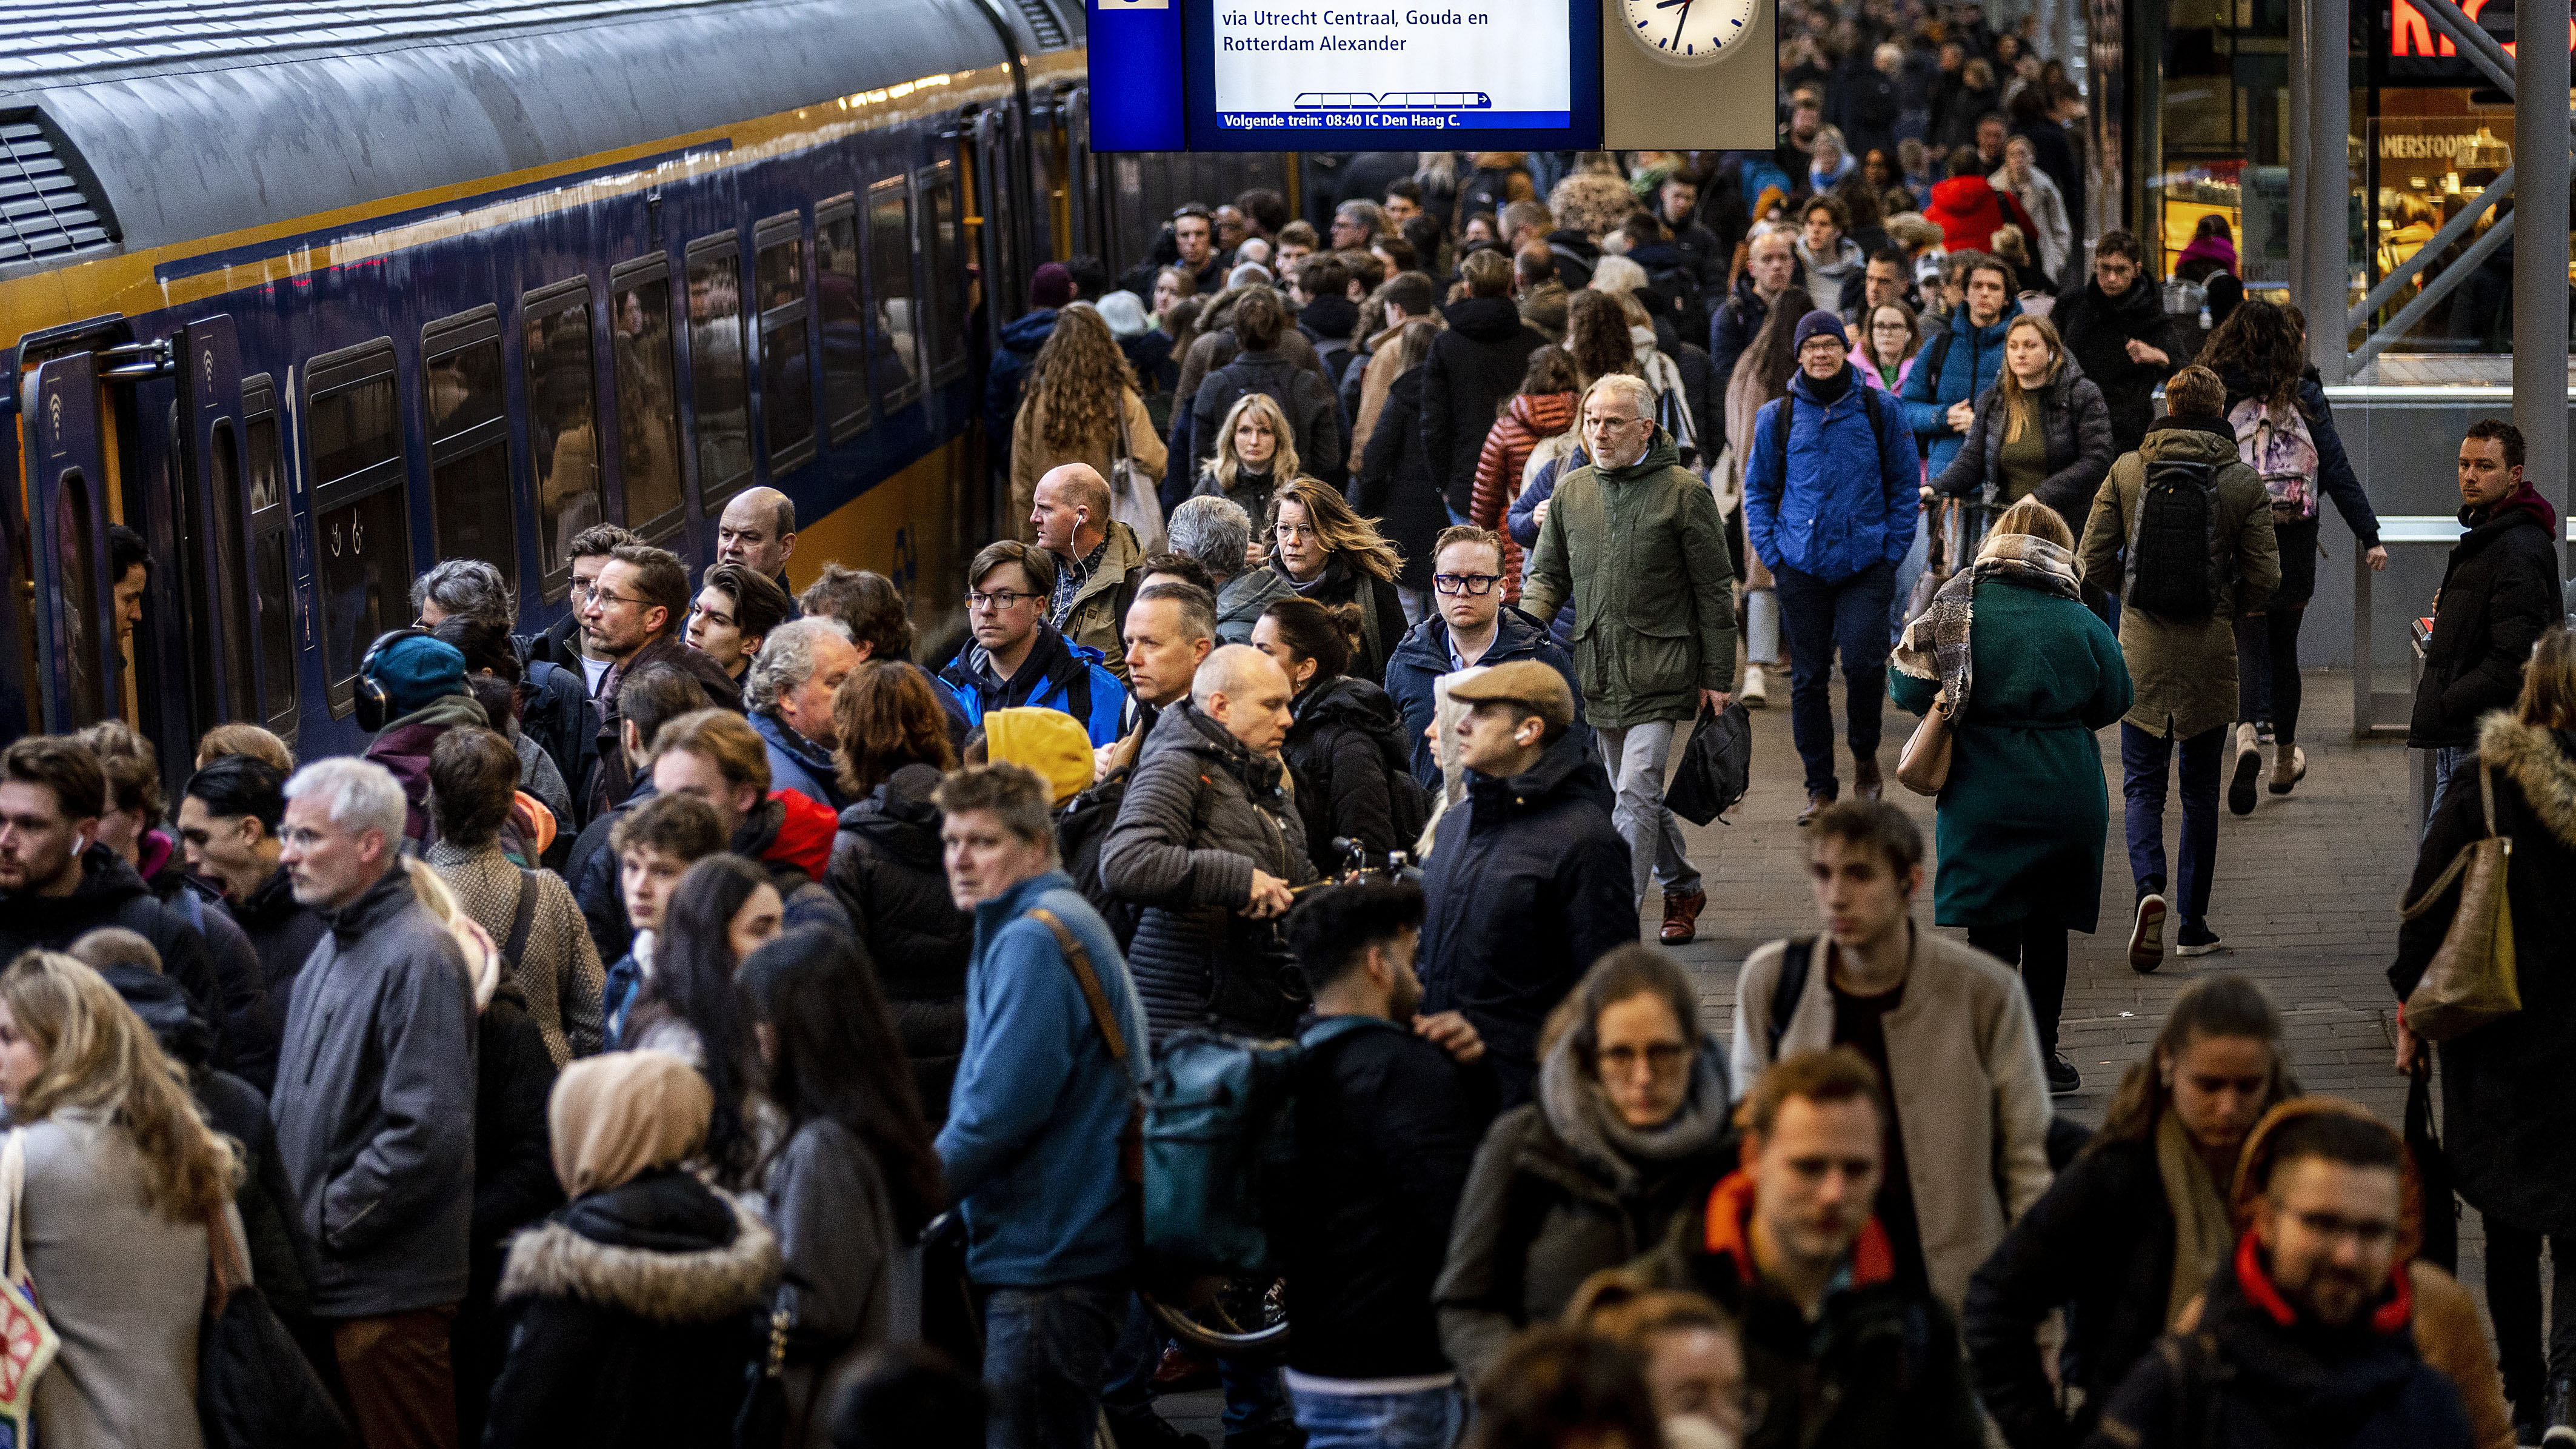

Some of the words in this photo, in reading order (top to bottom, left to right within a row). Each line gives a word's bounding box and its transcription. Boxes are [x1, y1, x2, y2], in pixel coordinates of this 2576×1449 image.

[1222, 10, 1247, 25] via
[1254, 9, 1317, 25] Utrecht
[1324, 9, 1398, 27] Centraal,
[1406, 9, 1461, 25] Gouda
[1468, 13, 1488, 25] en
[1223, 35, 1314, 51] Rotterdam
[1320, 35, 1407, 51] Alexander
[1224, 114, 1284, 130] Volgende
[1287, 114, 1322, 127] trein:
[1326, 114, 1362, 127] 08:40
[1366, 114, 1379, 126] IC
[1382, 114, 1407, 126] Den
[1411, 114, 1444, 129] Haag
[1448, 114, 1460, 126] C.
[285, 364, 302, 494] 1
